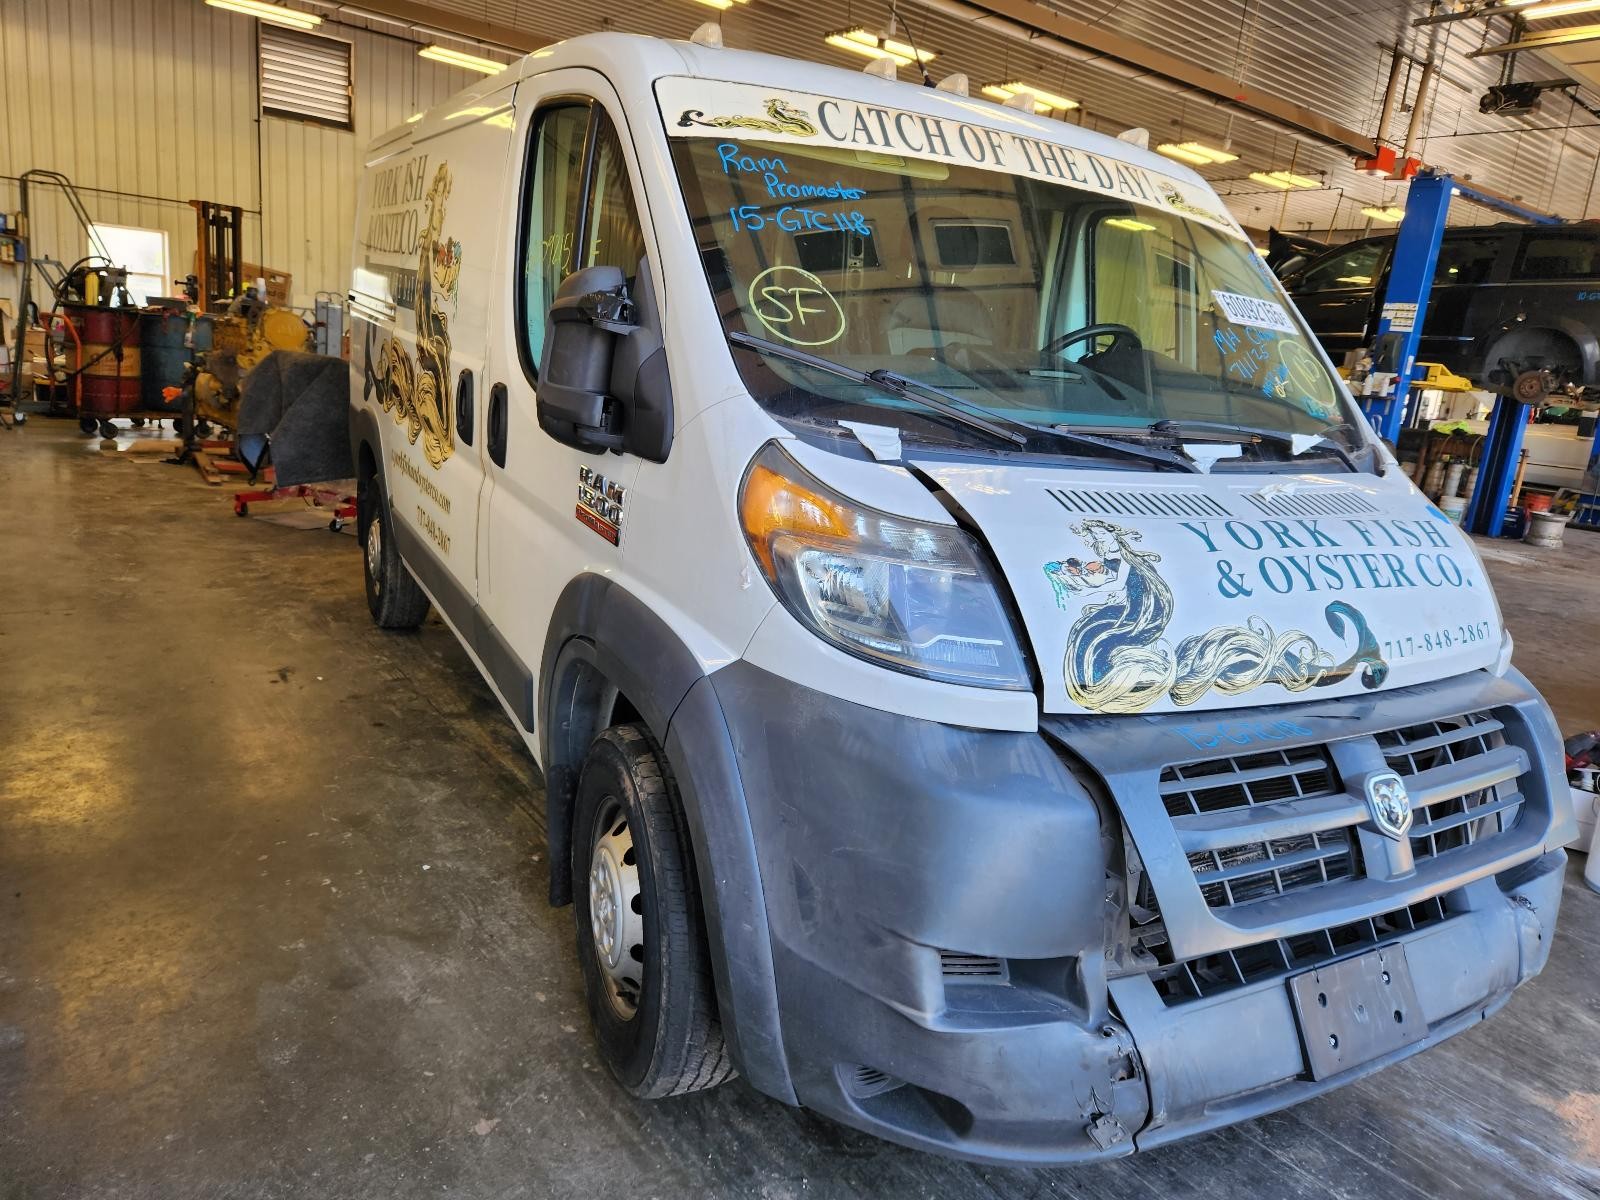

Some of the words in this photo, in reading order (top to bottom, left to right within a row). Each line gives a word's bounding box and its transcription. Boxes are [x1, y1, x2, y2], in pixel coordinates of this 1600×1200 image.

[717, 143, 789, 174] Ram
[817, 100, 956, 157] CATCH
[958, 124, 1007, 166] OF
[1012, 136, 1088, 183] THE
[1082, 155, 1161, 204] DAY!
[401, 154, 428, 205] ISH
[764, 172, 867, 200] Promaster
[729, 205, 871, 237] 15-GTC118
[758, 286, 826, 326] SF
[578, 464, 627, 508] RAM
[578, 483, 624, 526] 1500
[1179, 519, 1343, 553] YORK
[1344, 520, 1452, 549] FISH
[1216, 559, 1254, 600] &
[1257, 553, 1419, 594] OYSTER
[1414, 553, 1474, 589] CO.
[1384, 621, 1491, 660] 717-848-2867
